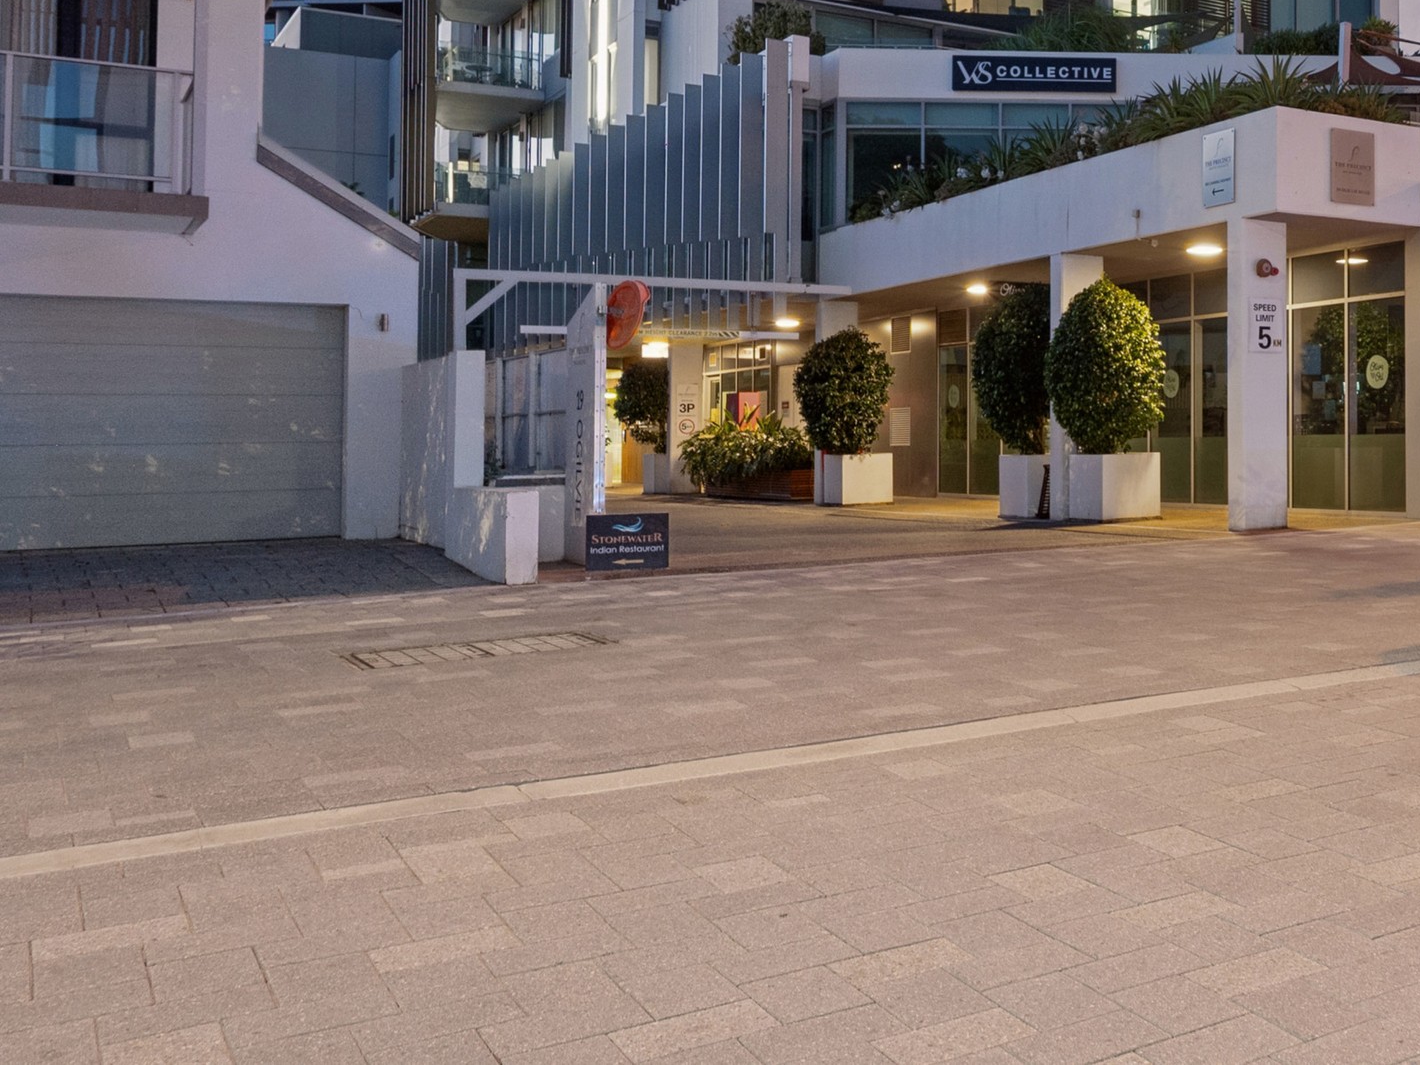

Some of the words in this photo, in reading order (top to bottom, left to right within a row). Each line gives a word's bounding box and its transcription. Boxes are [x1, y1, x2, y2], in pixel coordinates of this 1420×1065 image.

[996, 65, 1113, 79] COLLECTIVE
[1253, 303, 1277, 312] SPEED
[1256, 314, 1275, 322] LIMIT
[1258, 325, 1272, 349] 5
[679, 403, 696, 413] 3P
[591, 532, 663, 545] STONEWATER
[590, 546, 617, 554] Indian
[619, 544, 665, 554] Restaurant
